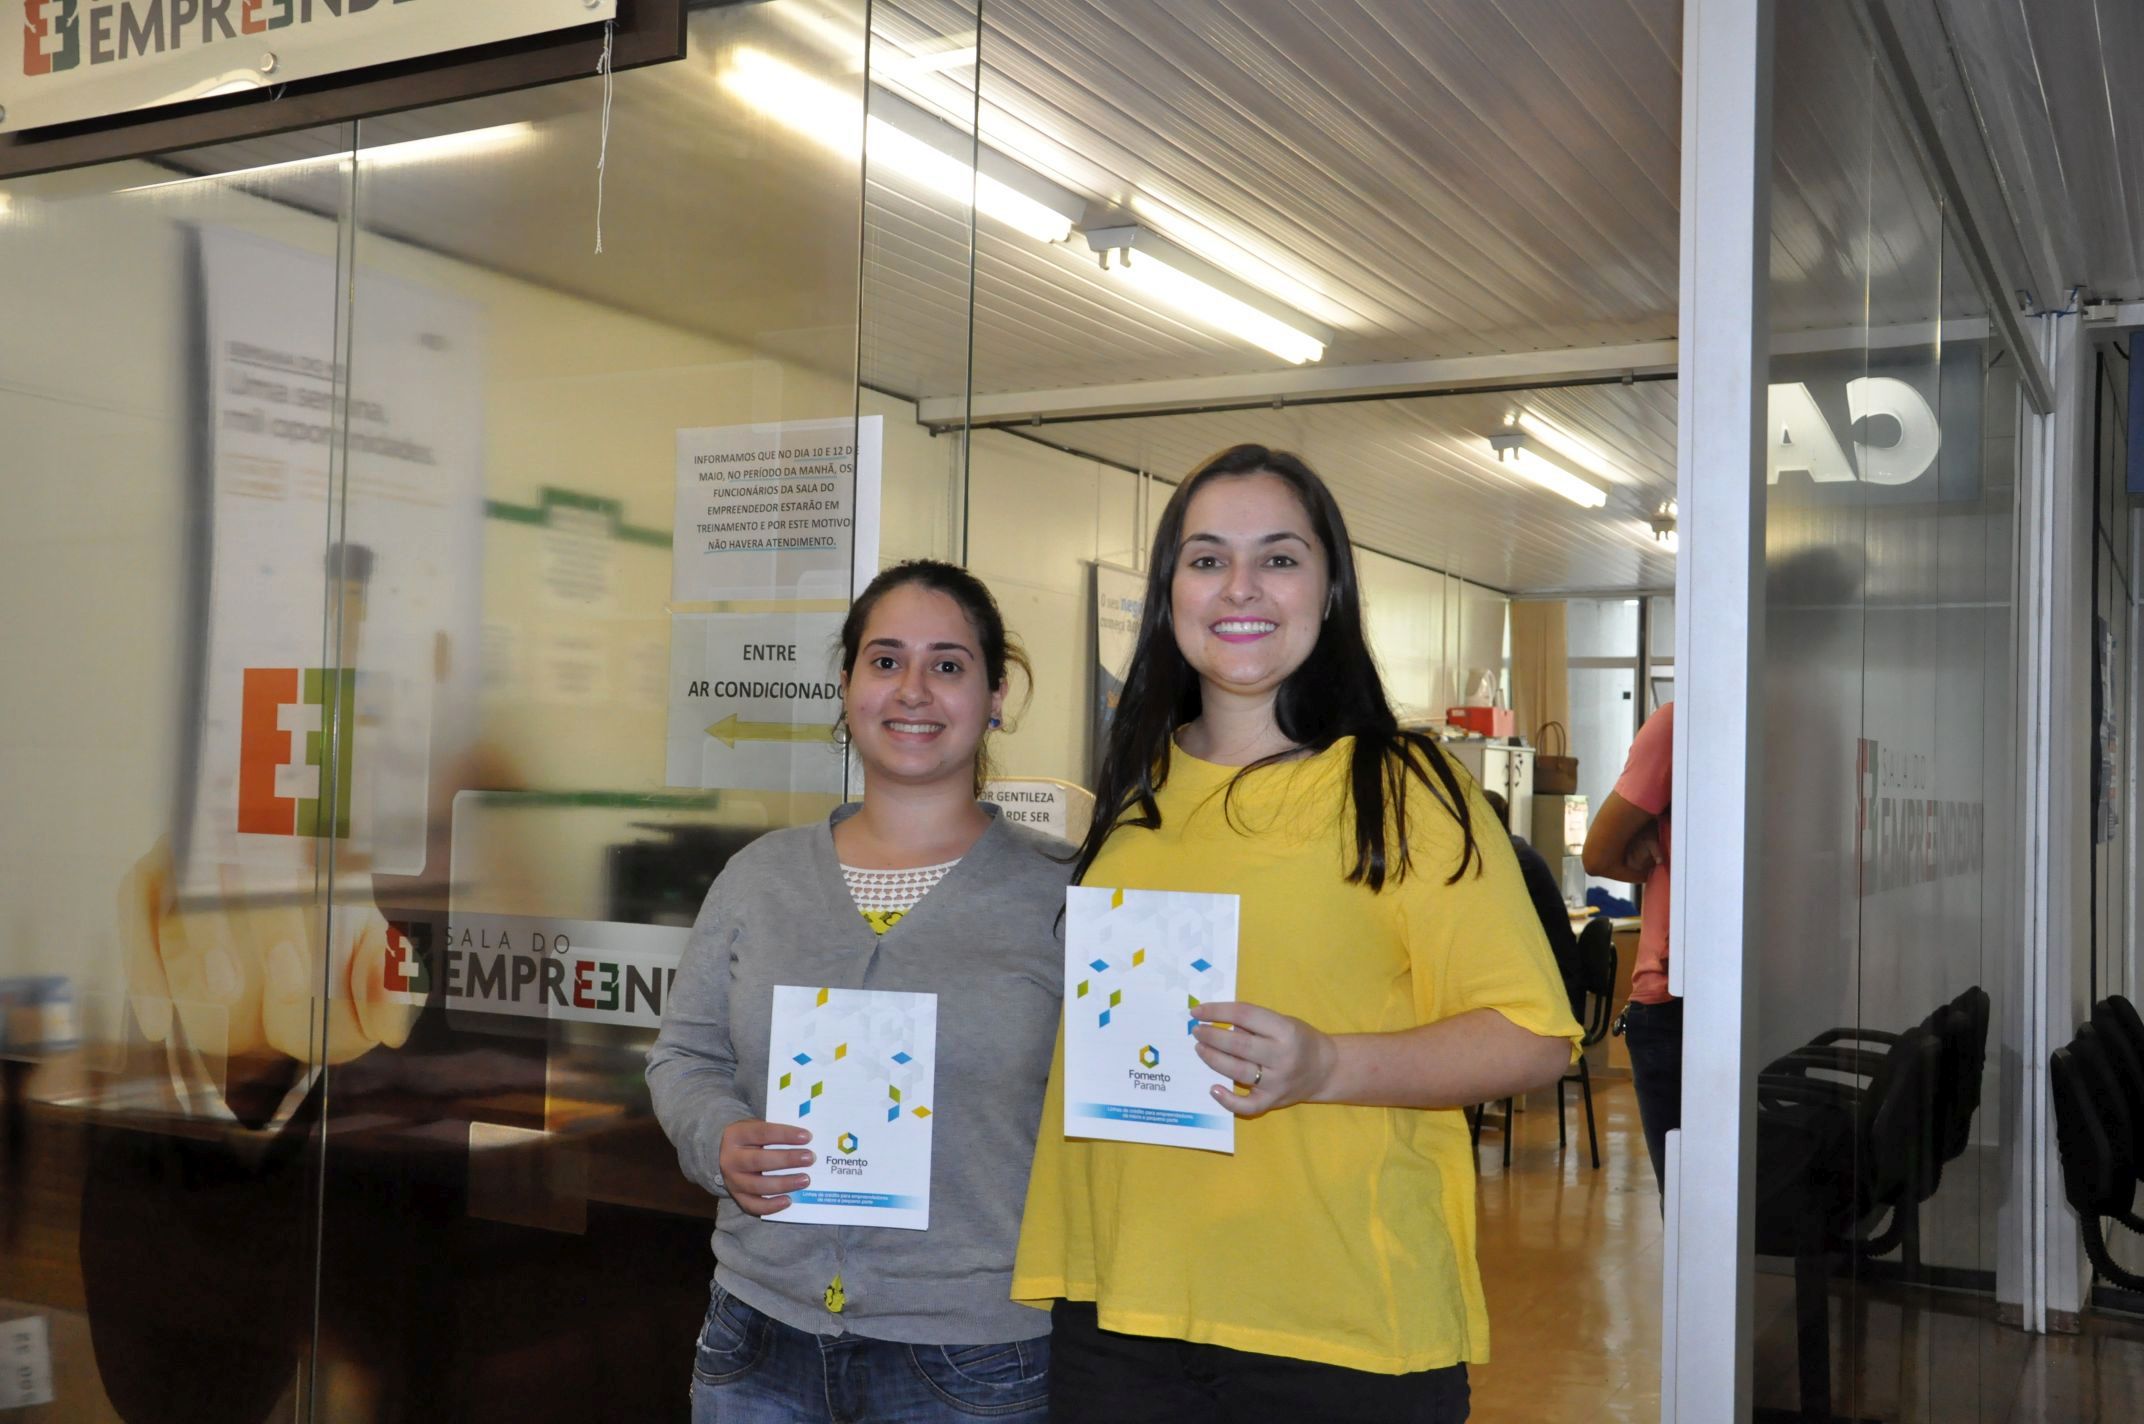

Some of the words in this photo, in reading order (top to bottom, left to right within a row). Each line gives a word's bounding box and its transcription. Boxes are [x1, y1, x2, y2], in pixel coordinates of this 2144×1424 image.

[694, 453, 756, 464] INFORMAMOS
[757, 450, 776, 462] QUE
[778, 449, 792, 460] NO
[794, 448, 810, 458] DIA
[812, 447, 823, 457] 10
[825, 447, 831, 456] E
[833, 446, 844, 456] 12
[699, 471, 726, 482] MAIO,
[728, 470, 741, 480] NO
[743, 465, 782, 479] PERÍODO
[784, 467, 797, 477] DA
[799, 463, 838, 477] MANHÃ,
[839, 463, 852, 474] OS
[713, 483, 779, 498] FUNCIONÁRIOS
[780, 484, 793, 494] DA
[795, 483, 818, 494] SALA
[820, 482, 835, 492] DO
[707, 503, 779, 515] EMPREENDEDOR
[780, 499, 822, 512] ESTARÃO
[824, 500, 839, 510] EM
[696, 521, 758, 534] TREINAMENTO
[760, 520, 766, 530] E
[767, 519, 786, 530] POR
[788, 519, 809, 529] ESTE
[811, 517, 851, 529] MOTIVO
[708, 536, 727, 550] NÃO
[766, 537, 837, 548] ATENDIMENTO.
[743, 644, 797, 661] ENTRE
[688, 680, 710, 698] AR
[996, 791, 1055, 803] GENTILEZA
[1006, 810, 1028, 822] RDE
[1030, 810, 1050, 822] SER
[444, 926, 511, 950] SALA
[532, 932, 571, 954] DO
[1128, 1069, 1171, 1082] Fomento
[1134, 1079, 1166, 1092] Paraná
[826, 1155, 868, 1167] Fomento
[830, 1165, 863, 1176] Paraná
